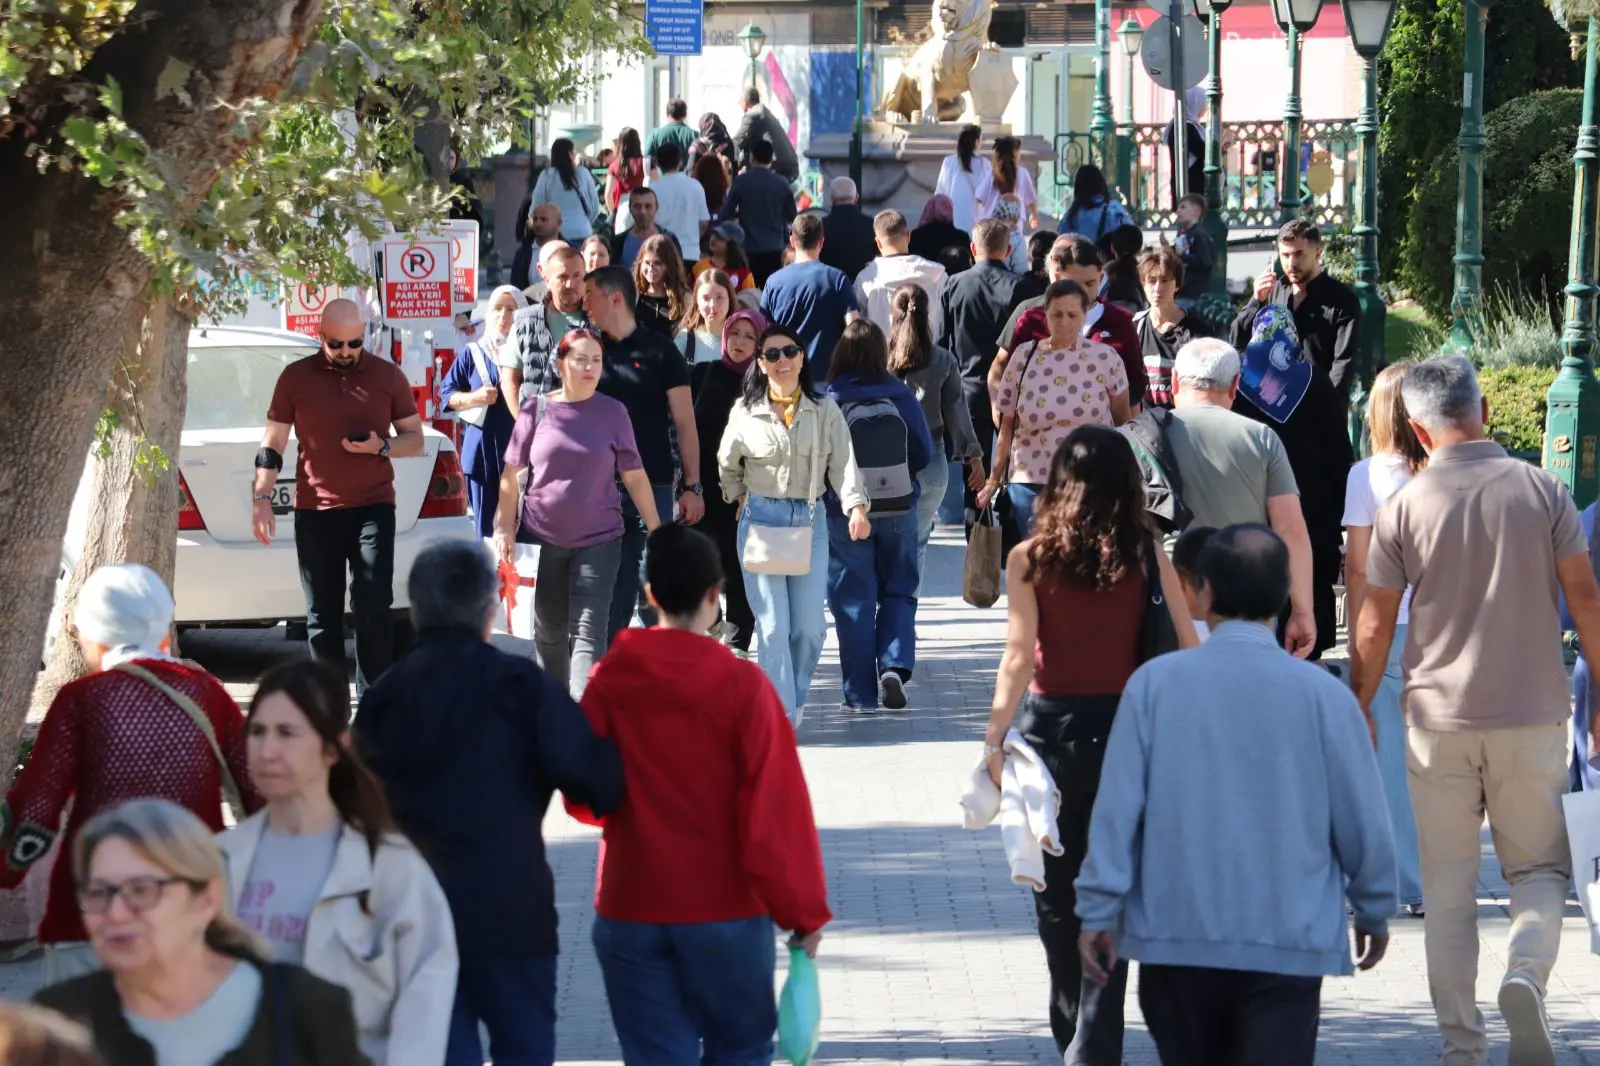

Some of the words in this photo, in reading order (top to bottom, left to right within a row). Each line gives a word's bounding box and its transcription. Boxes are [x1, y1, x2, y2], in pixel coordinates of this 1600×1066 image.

[709, 29, 734, 45] QNB
[413, 282, 440, 290] ARACI
[395, 291, 419, 299] PARK
[421, 290, 441, 299] YERİ
[390, 300, 415, 308] PARK
[416, 300, 447, 308] ETMEK
[397, 309, 441, 317] YASAKTIR
[271, 486, 291, 505] 26
